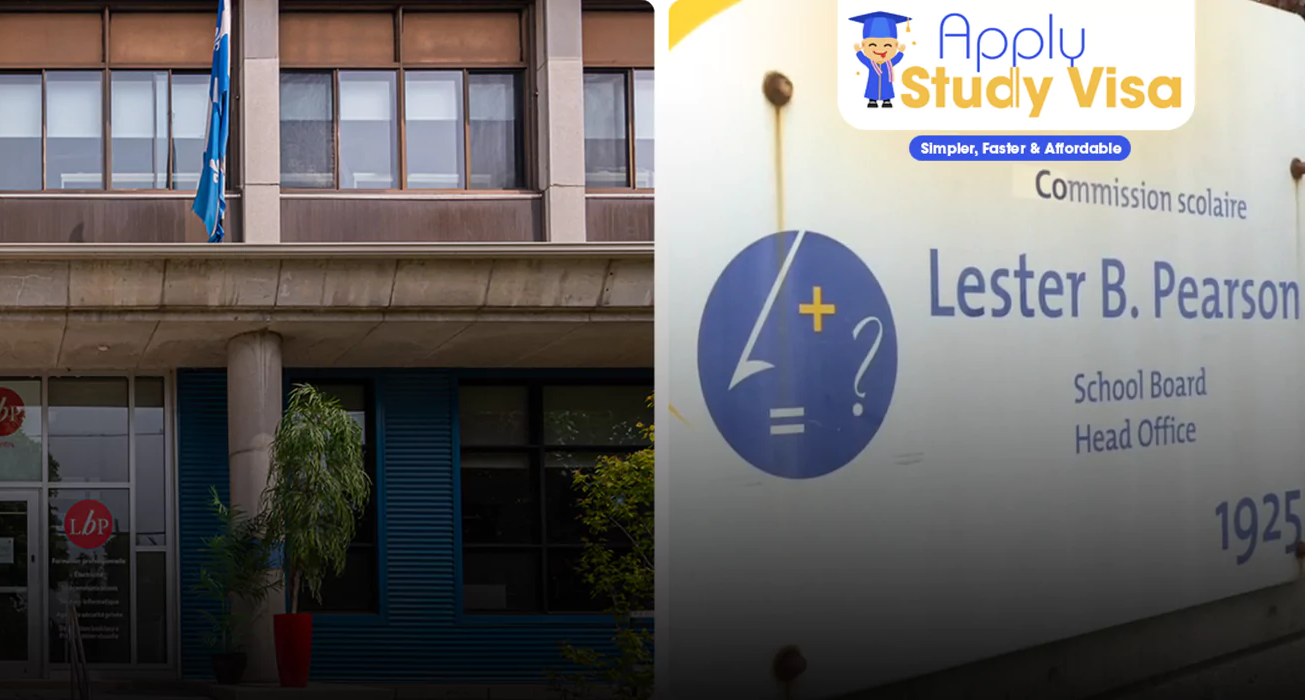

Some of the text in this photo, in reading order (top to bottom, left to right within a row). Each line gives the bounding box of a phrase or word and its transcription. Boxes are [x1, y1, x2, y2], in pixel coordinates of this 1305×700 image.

[1035, 170, 1247, 220] Commission scolaire
[930, 249, 1300, 320] Lester B. Pearson
[1074, 366, 1207, 403] School Board
[1075, 415, 1197, 454] Head Office
[69, 509, 110, 536] LbP
[1215, 489, 1302, 566] 1925
